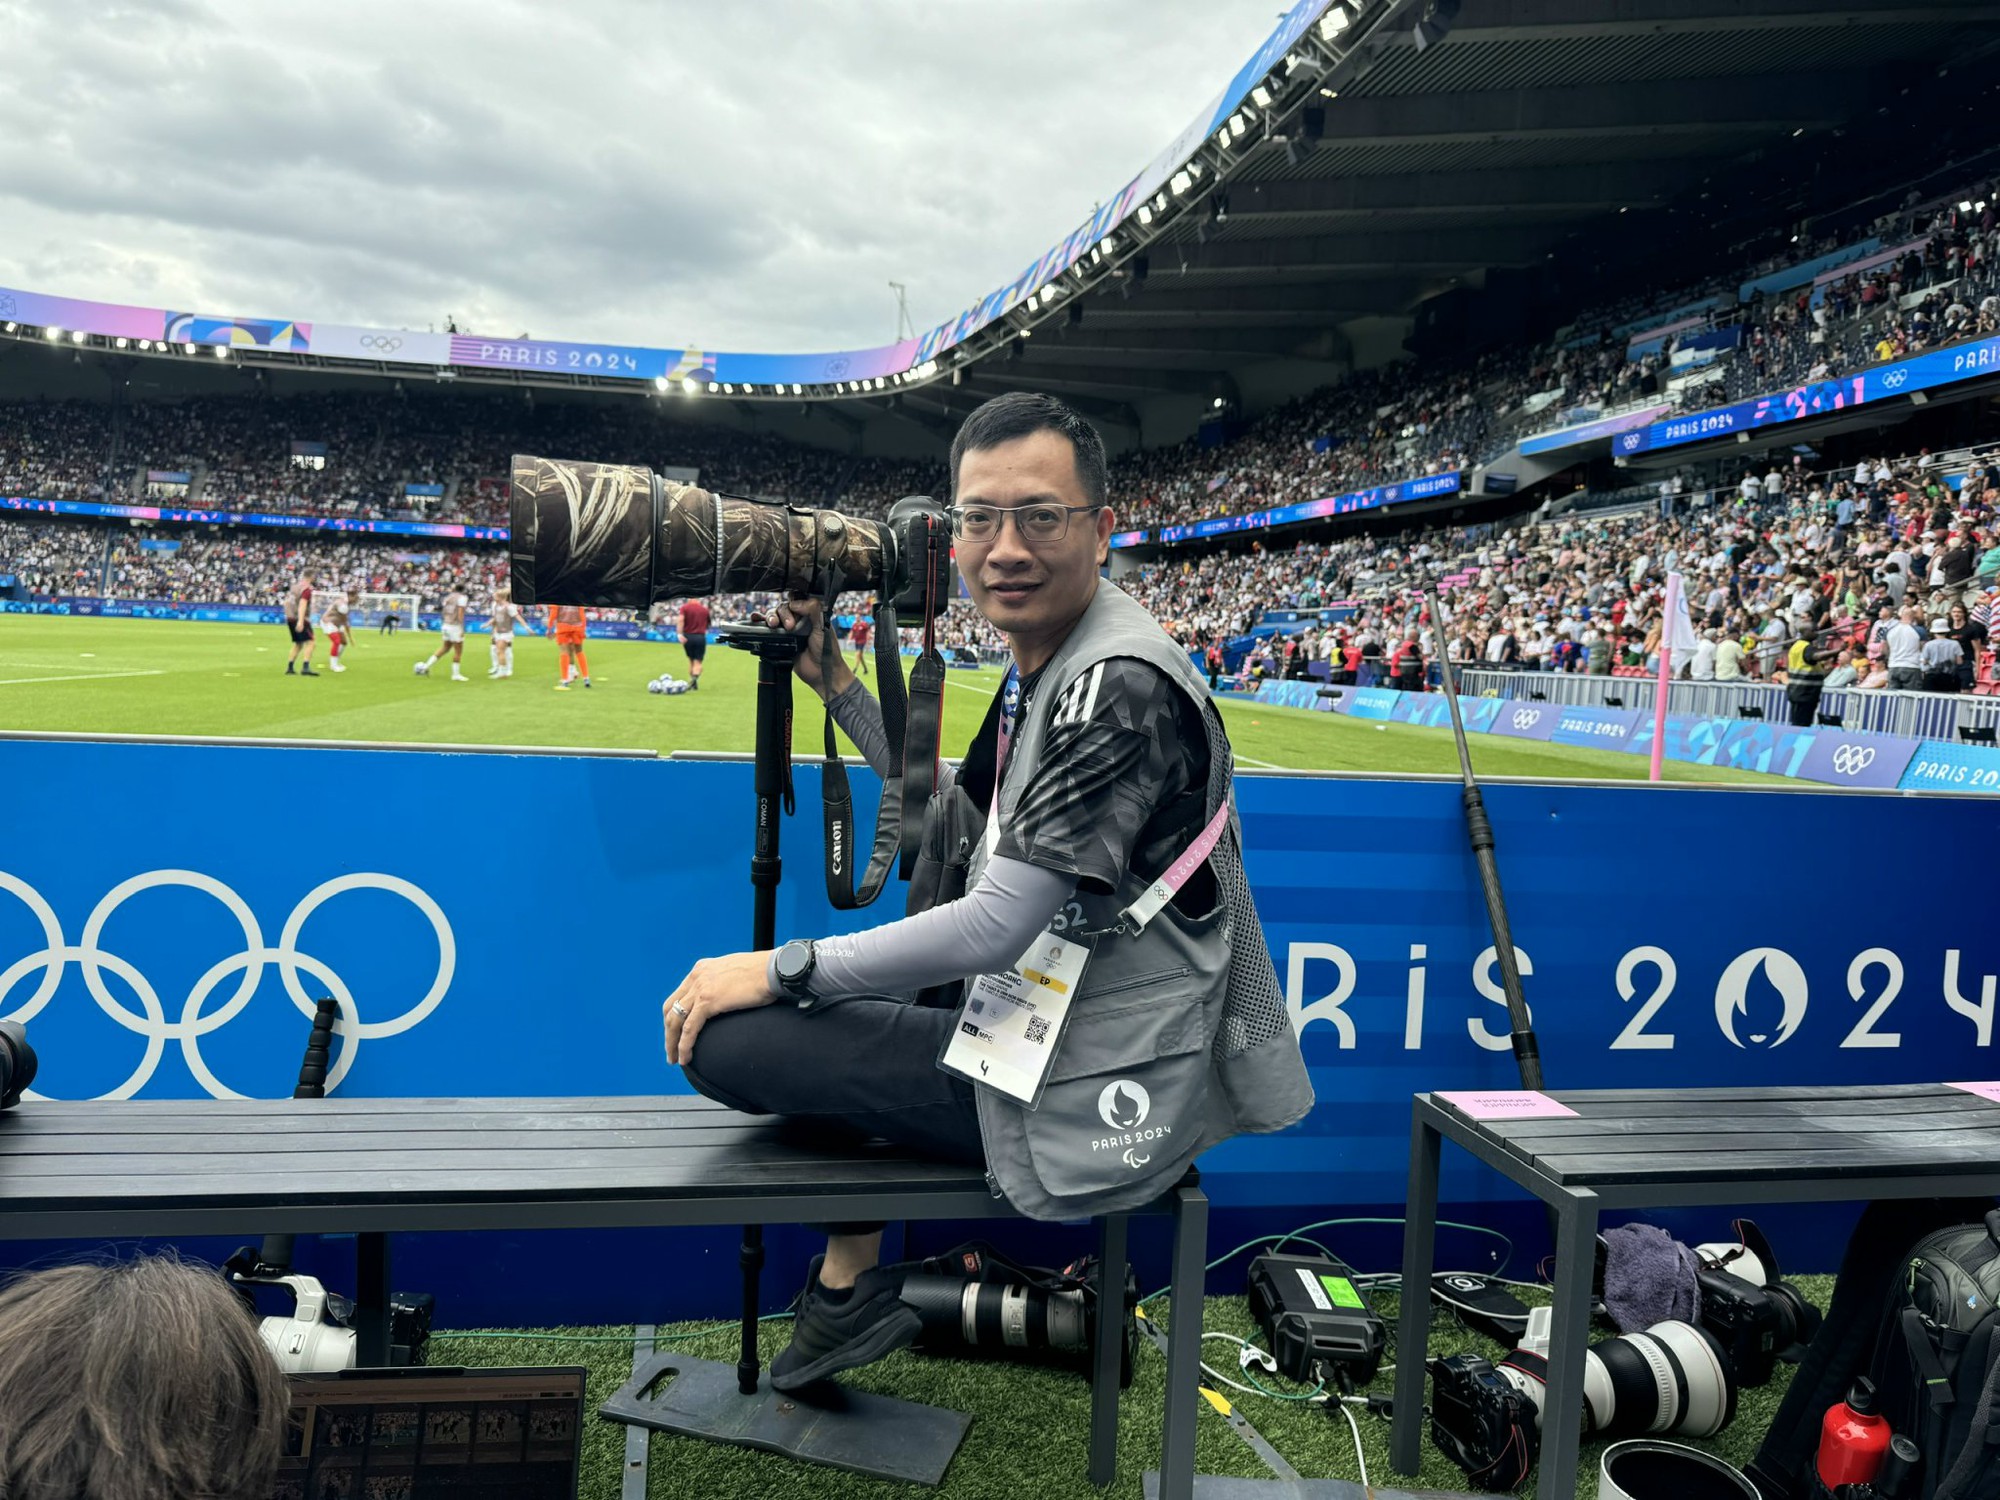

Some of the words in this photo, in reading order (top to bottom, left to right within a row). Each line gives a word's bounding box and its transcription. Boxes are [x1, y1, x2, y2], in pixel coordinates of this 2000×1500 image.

[480, 345, 557, 366] PARIS
[569, 351, 637, 371] 2024
[1666, 420, 1699, 439] PARIS
[1701, 413, 1733, 433] 2024
[1561, 719, 1594, 734] PARIS
[1593, 723, 1626, 738] 2024
[1969, 768, 2000, 789] 20
[832, 820, 842, 876] Canon
[1039, 976, 1051, 986] EP
[1608, 945, 1998, 1050] 2024
[963, 1024, 977, 1035] ALL
[979, 1031, 993, 1042] MPC
[980, 1059, 989, 1076] 4
[1091, 1134, 1132, 1151] PARIS
[1135, 1125, 1171, 1143] 2024
